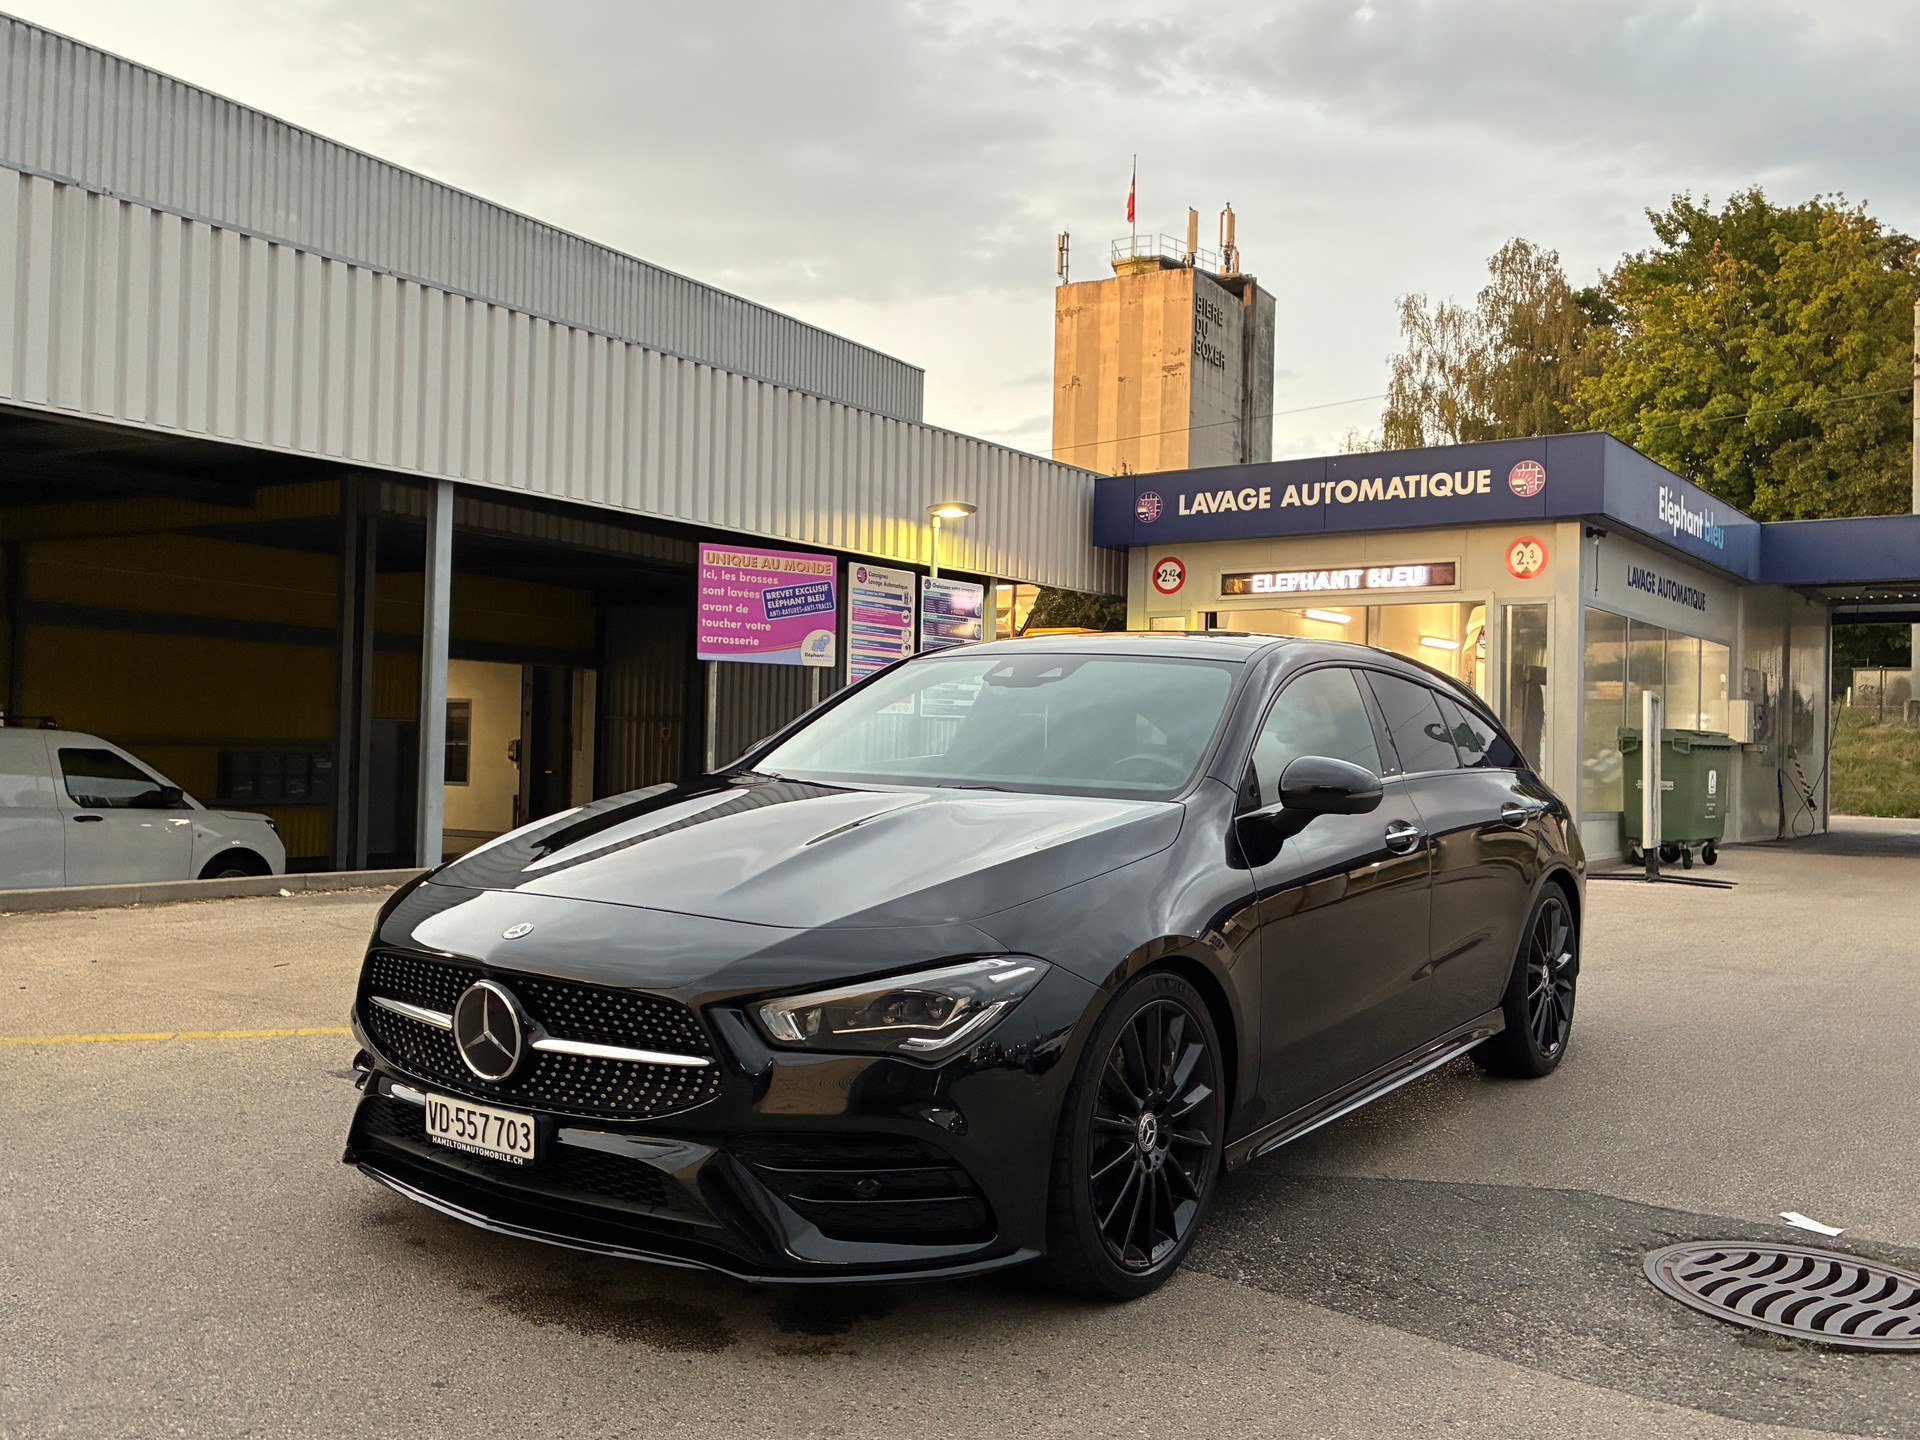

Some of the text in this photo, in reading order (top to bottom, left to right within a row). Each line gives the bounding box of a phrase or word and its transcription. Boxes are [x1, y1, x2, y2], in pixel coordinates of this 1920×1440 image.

[1194, 315, 1208, 338] DU
[1194, 336, 1225, 370] BOXER
[1178, 469, 1492, 516] LAVAGE AUTOMATIQUE
[1658, 485, 1724, 550] Eléphant bleu
[705, 551, 831, 575] UNIQUE AU MONDE
[703, 569, 778, 584] Ici, les brosses
[1252, 566, 1425, 593] ELEPHANT BLEU
[1627, 564, 1706, 612] LAVAGE AUTOMATIQUE
[702, 587, 760, 599] sont lavées
[766, 584, 829, 600] BREVET EXCLUSIF
[807, 593, 825, 603] BLEU
[702, 603, 749, 614] avant de
[702, 618, 772, 631] toucher votre
[702, 634, 760, 646] carrosserie
[432, 1135, 524, 1165] HAMILTONAUTOMOBILE.CH
